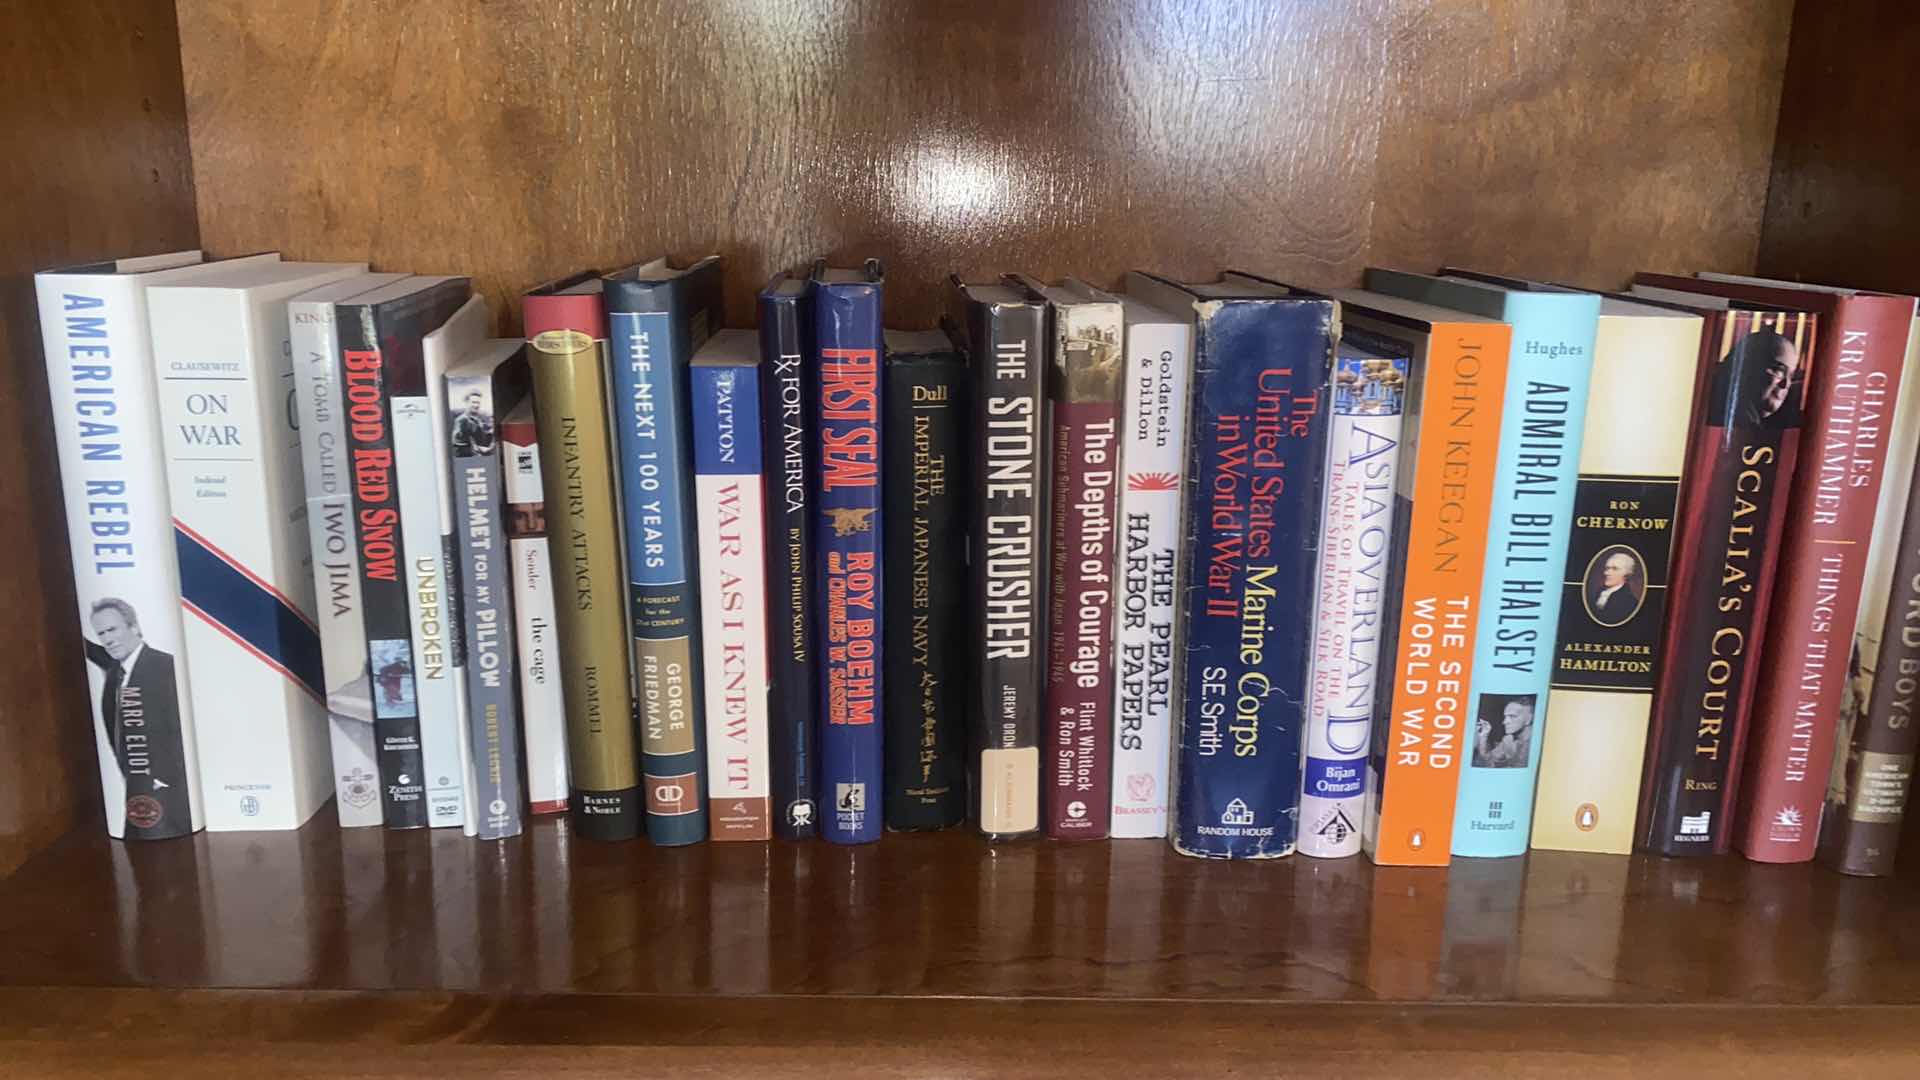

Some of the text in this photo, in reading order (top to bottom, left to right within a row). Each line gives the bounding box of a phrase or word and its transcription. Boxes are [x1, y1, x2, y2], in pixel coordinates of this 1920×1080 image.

[295, 312, 333, 324] KING
[170, 361, 239, 372] CLAUSEWITZ
[1525, 341, 1584, 359] Hughes
[186, 393, 228, 415] ON
[716, 380, 735, 463] PATTON
[781, 377, 801, 419] FOR
[821, 348, 878, 493] FIRST SEAL
[912, 384, 948, 401] Dull
[1138, 358, 1153, 441] & Dillon
[1156, 350, 1173, 448] Goldstein
[1290, 388, 1319, 439] The
[62, 292, 134, 574] AMERICAN REBEL
[180, 424, 241, 446] WAR
[629, 331, 665, 569] THE NEXT 100 YEARS
[1055, 424, 1072, 474] American
[1432, 337, 1483, 573] JOHN KEEGAN
[1812, 330, 1868, 525] KRAUTHAMMER
[1848, 371, 1888, 487] CHARLES
[311, 351, 352, 618] A TOMB CALLED IWO JIMA
[344, 349, 399, 582] BLOOD RED SNOW
[784, 423, 804, 513] AMERICA
[930, 455, 945, 496] THE
[561, 416, 593, 612] INFANTRY ATTACKS
[717, 483, 741, 557] WAR
[986, 339, 1033, 660] THE STONE CRUSHER
[1206, 415, 1251, 618] in World War II
[1492, 380, 1571, 673] ADMIRAL BILL HALSEY
[1576, 516, 1670, 530] CHERNOW
[1609, 500, 1641, 510] RON
[828, 551, 847, 575] and
[912, 415, 929, 667] IMPERIAL JAPANESE NAVY
[1055, 552, 1068, 572] War
[1056, 542, 1068, 552] at
[1069, 418, 1115, 688] The Depths of Courage
[1228, 367, 1294, 757] United States Marine Corps
[465, 467, 501, 689] HELMET FOR MY PILLOW
[527, 549, 541, 593] Sender
[642, 595, 681, 605] FORECAST
[720, 569, 743, 612] AS
[788, 528, 805, 662] BY JOHN PHILIP SOUSA IV
[1054, 574, 1066, 595] with
[1327, 481, 1360, 698] TALES OF TRAVEL ON THE
[415, 556, 445, 680] UNBROKEN
[651, 617, 685, 627] CENTURY
[658, 607, 671, 616] the
[723, 620, 744, 631] I
[847, 551, 875, 725] ROY BOEHM
[1054, 601, 1065, 626] Japan
[1120, 512, 1150, 751] HARBOR PAPERS
[1147, 548, 1174, 717] THE PEARL
[529, 617, 548, 685] the cage
[1317, 629, 1331, 663] SILK
[1560, 657, 1653, 673] HAMILTON
[1564, 642, 1651, 654] ALEXANDER
[1784, 553, 1844, 782] THINGS THAT MATTER
[120, 686, 144, 727] MARC
[583, 665, 602, 736] ROMMEL
[642, 655, 664, 741] FRIEDMAN
[666, 663, 685, 731] GEORGE
[723, 642, 749, 744] KNEW
[829, 667, 847, 725] SASSER
[1002, 684, 1017, 720] JEREMY
[1313, 670, 1329, 717] ROAD
[1397, 597, 1438, 766] WORLD WAR
[1429, 595, 1470, 769] THE SECOND
[1695, 627, 1744, 760] COURT
[1887, 658, 1919, 730] BOYS
[126, 735, 150, 776] ELIOT
[1058, 706, 1077, 787] & Ron Smith
[1077, 701, 1097, 792] Flint Whitlock
[1199, 702, 1226, 756] Smith
[583, 795, 622, 805] BARNES
[727, 757, 749, 790] IT
[1315, 778, 1361, 792] Omrani
[1325, 766, 1356, 781] Bijan
[837, 812, 865, 821] POCKET
[838, 821, 864, 830] BOOKS
[1197, 825, 1274, 836] RANDOM HOUSE
[1470, 819, 1516, 831] Harvard
